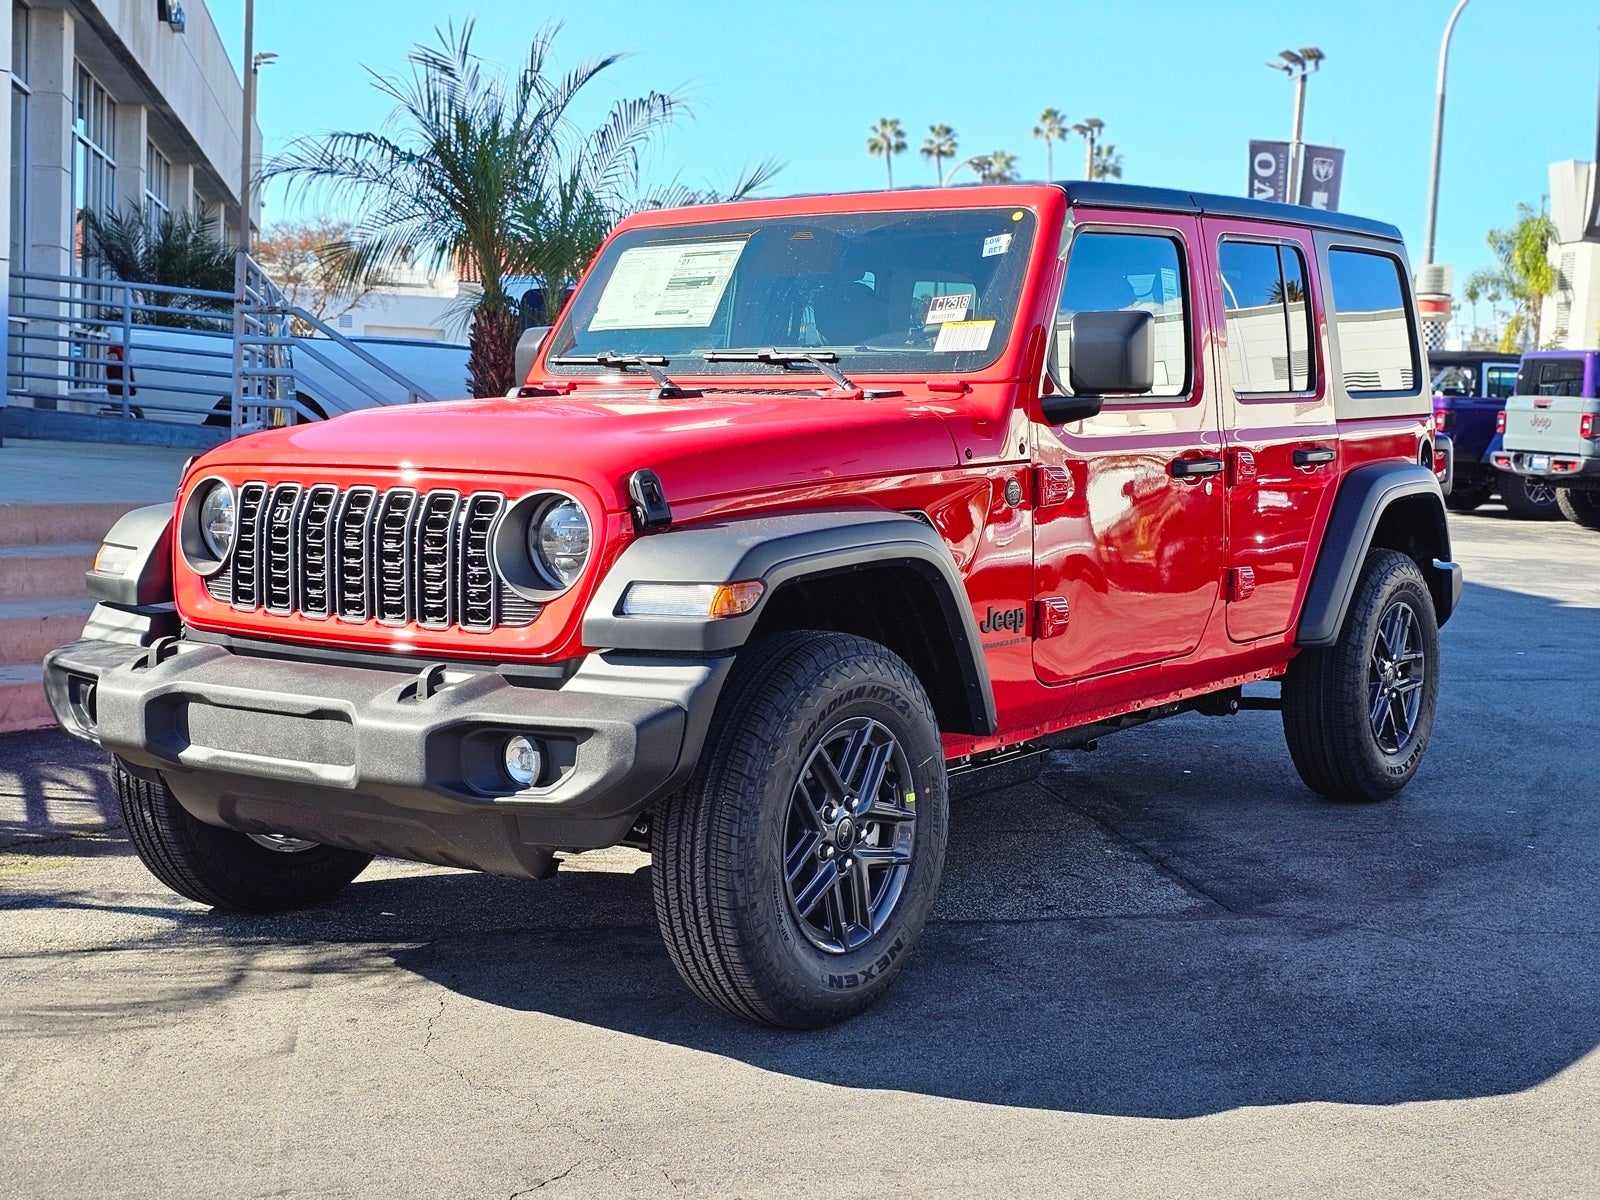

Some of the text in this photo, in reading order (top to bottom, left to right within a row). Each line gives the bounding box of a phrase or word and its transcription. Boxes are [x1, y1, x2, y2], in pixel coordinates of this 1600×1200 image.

[985, 237, 1001, 246] LOW
[988, 246, 1003, 255] RET
[1530, 414, 1551, 430] Jeep
[980, 606, 1025, 633] Jeep
[798, 685, 867, 757] ROADIAN
[1389, 743, 1421, 775] NEXEN
[828, 937, 904, 989] NEXEN
